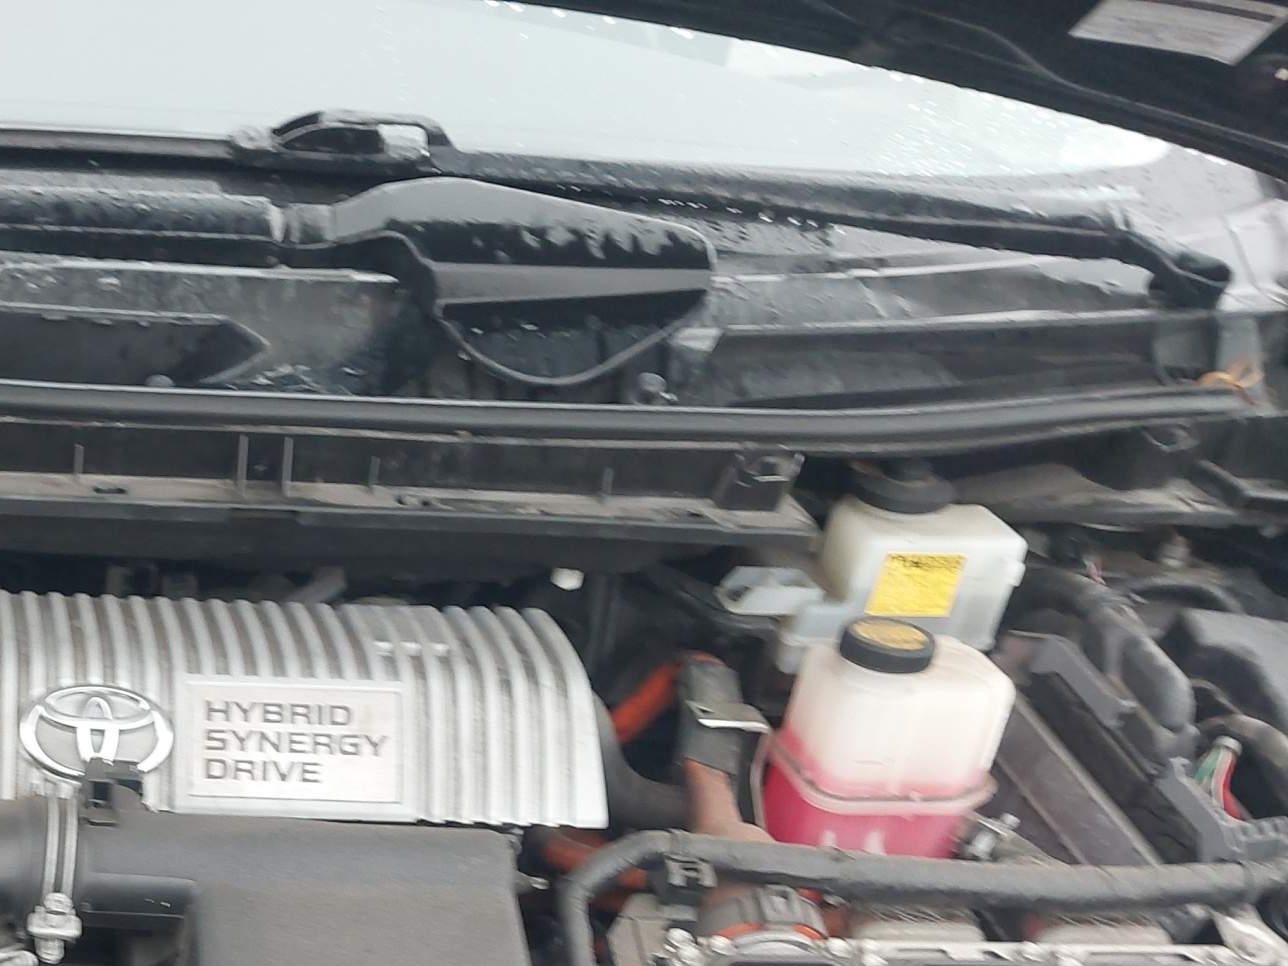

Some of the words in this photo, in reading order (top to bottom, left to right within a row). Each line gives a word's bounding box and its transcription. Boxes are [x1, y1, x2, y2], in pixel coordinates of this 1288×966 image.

[206, 700, 353, 726] HYBRID
[205, 729, 388, 757] SYNERGY
[205, 758, 323, 783] DRIVE
